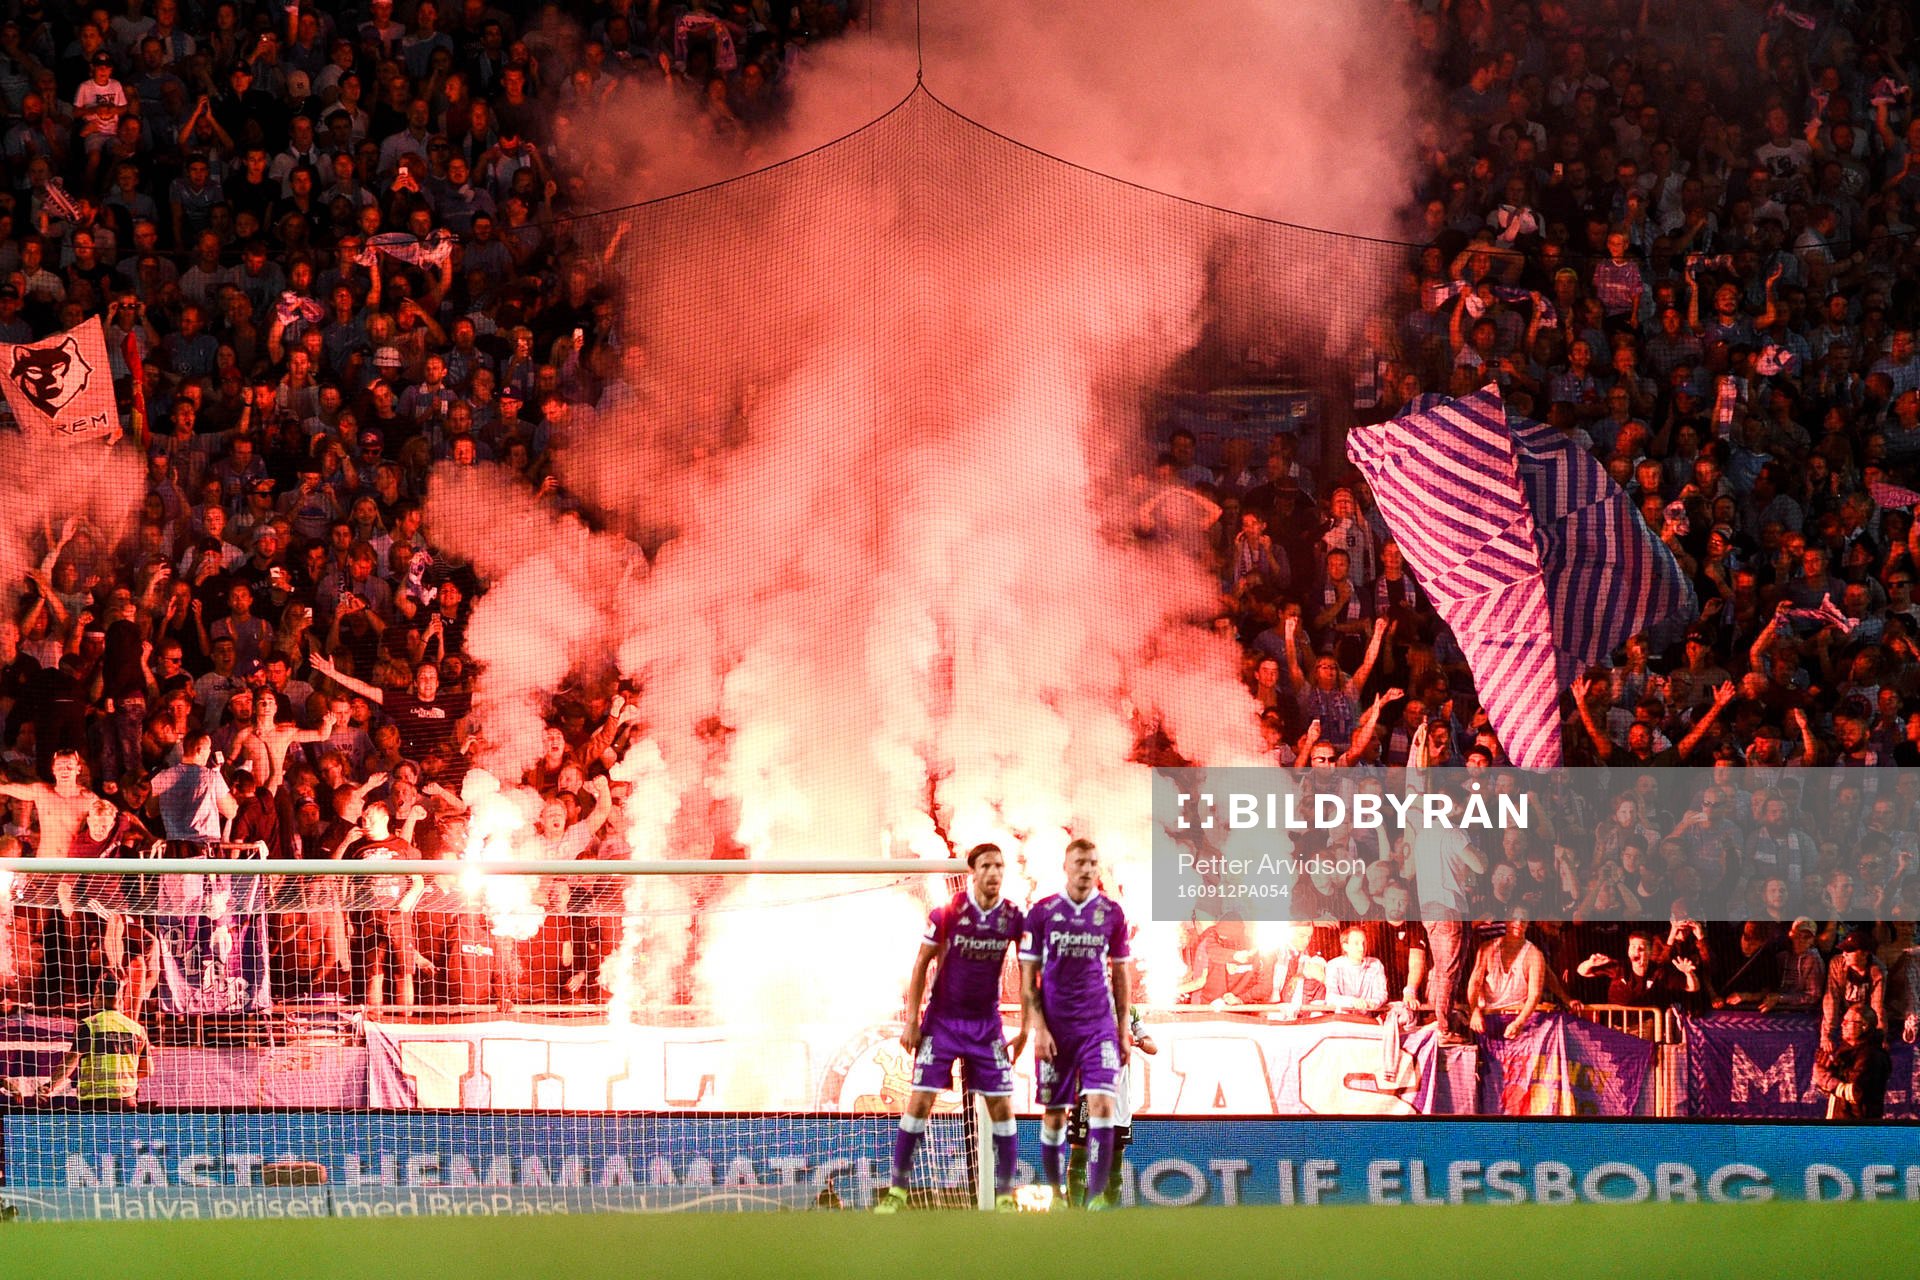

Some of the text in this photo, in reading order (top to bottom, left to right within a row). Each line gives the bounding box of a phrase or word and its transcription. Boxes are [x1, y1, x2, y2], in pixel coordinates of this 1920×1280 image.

[66, 1138, 304, 1187] NÄST
[1278, 1159, 1337, 1206] IF
[1366, 1159, 1776, 1206] ELFSBORG
[93, 1190, 570, 1220] Halva priset med BroPass
